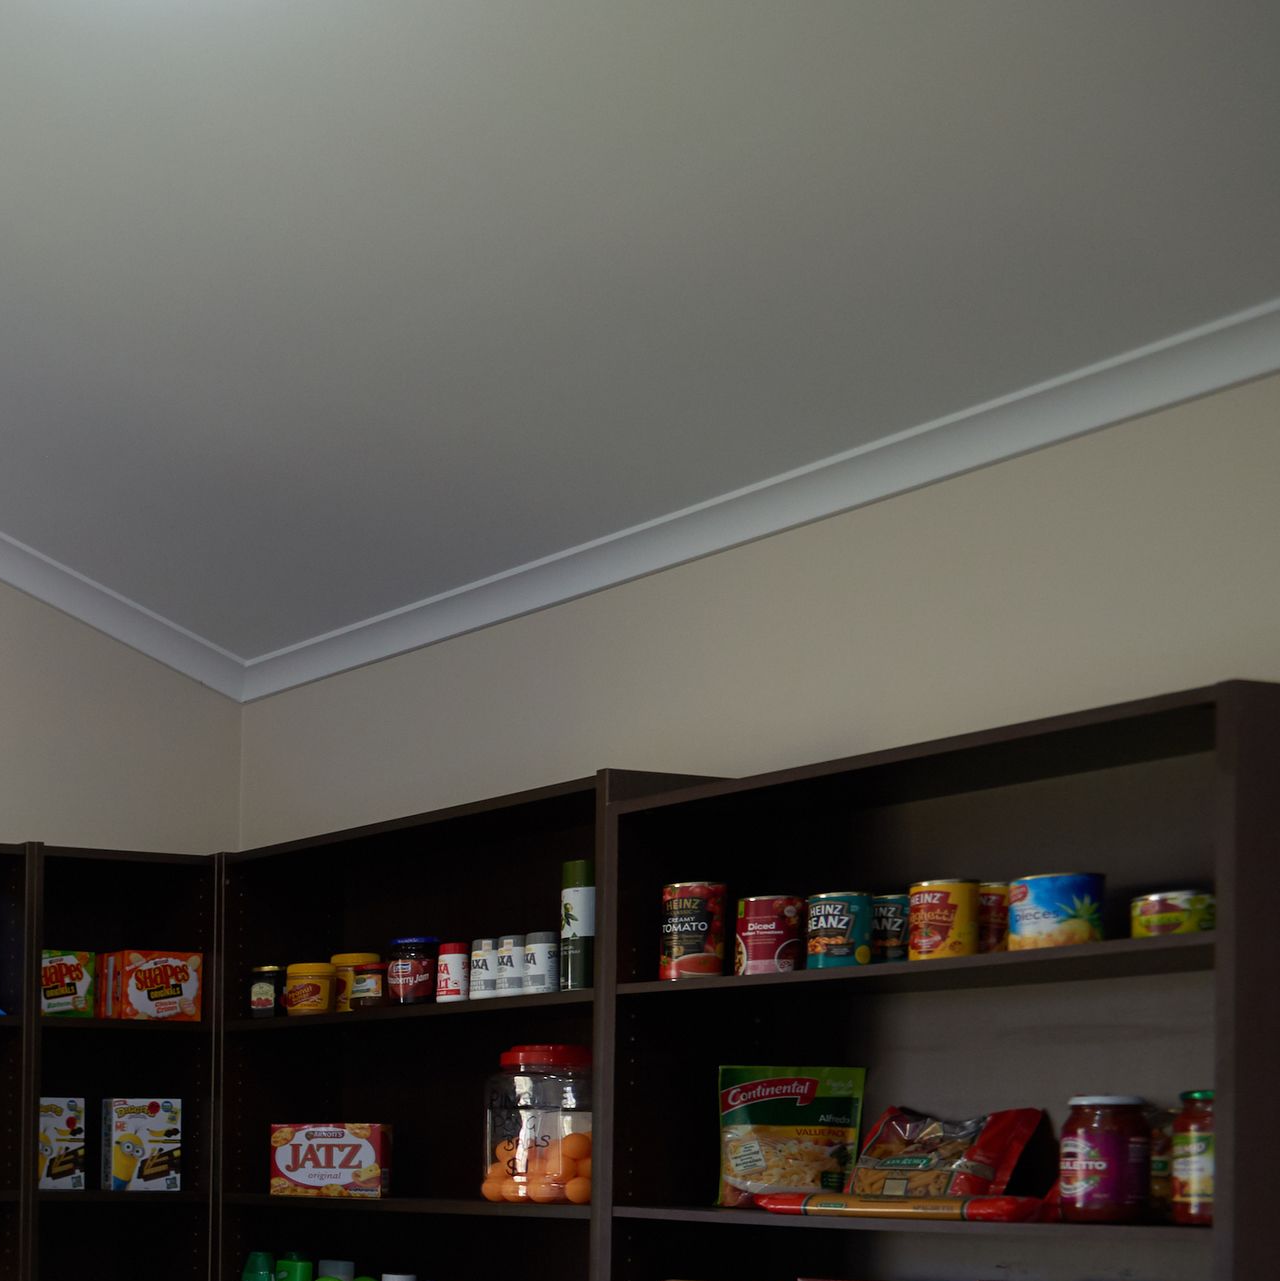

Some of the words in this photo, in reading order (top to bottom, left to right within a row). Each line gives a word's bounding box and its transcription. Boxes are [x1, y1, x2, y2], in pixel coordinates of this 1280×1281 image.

[666, 899, 700, 911] HEINZ
[810, 905, 842, 916] HEINZ
[874, 907, 896, 917] INZ
[910, 907, 954, 923] aghetti
[1014, 909, 1060, 923] pieces
[662, 921, 708, 933] TOMATO
[747, 922, 776, 931] Diced
[873, 918, 905, 932] ANZ
[727, 1080, 810, 1105] Continental
[818, 1114, 851, 1124] Alfredo
[285, 1143, 362, 1172] JATZ
[307, 1172, 342, 1181] original
